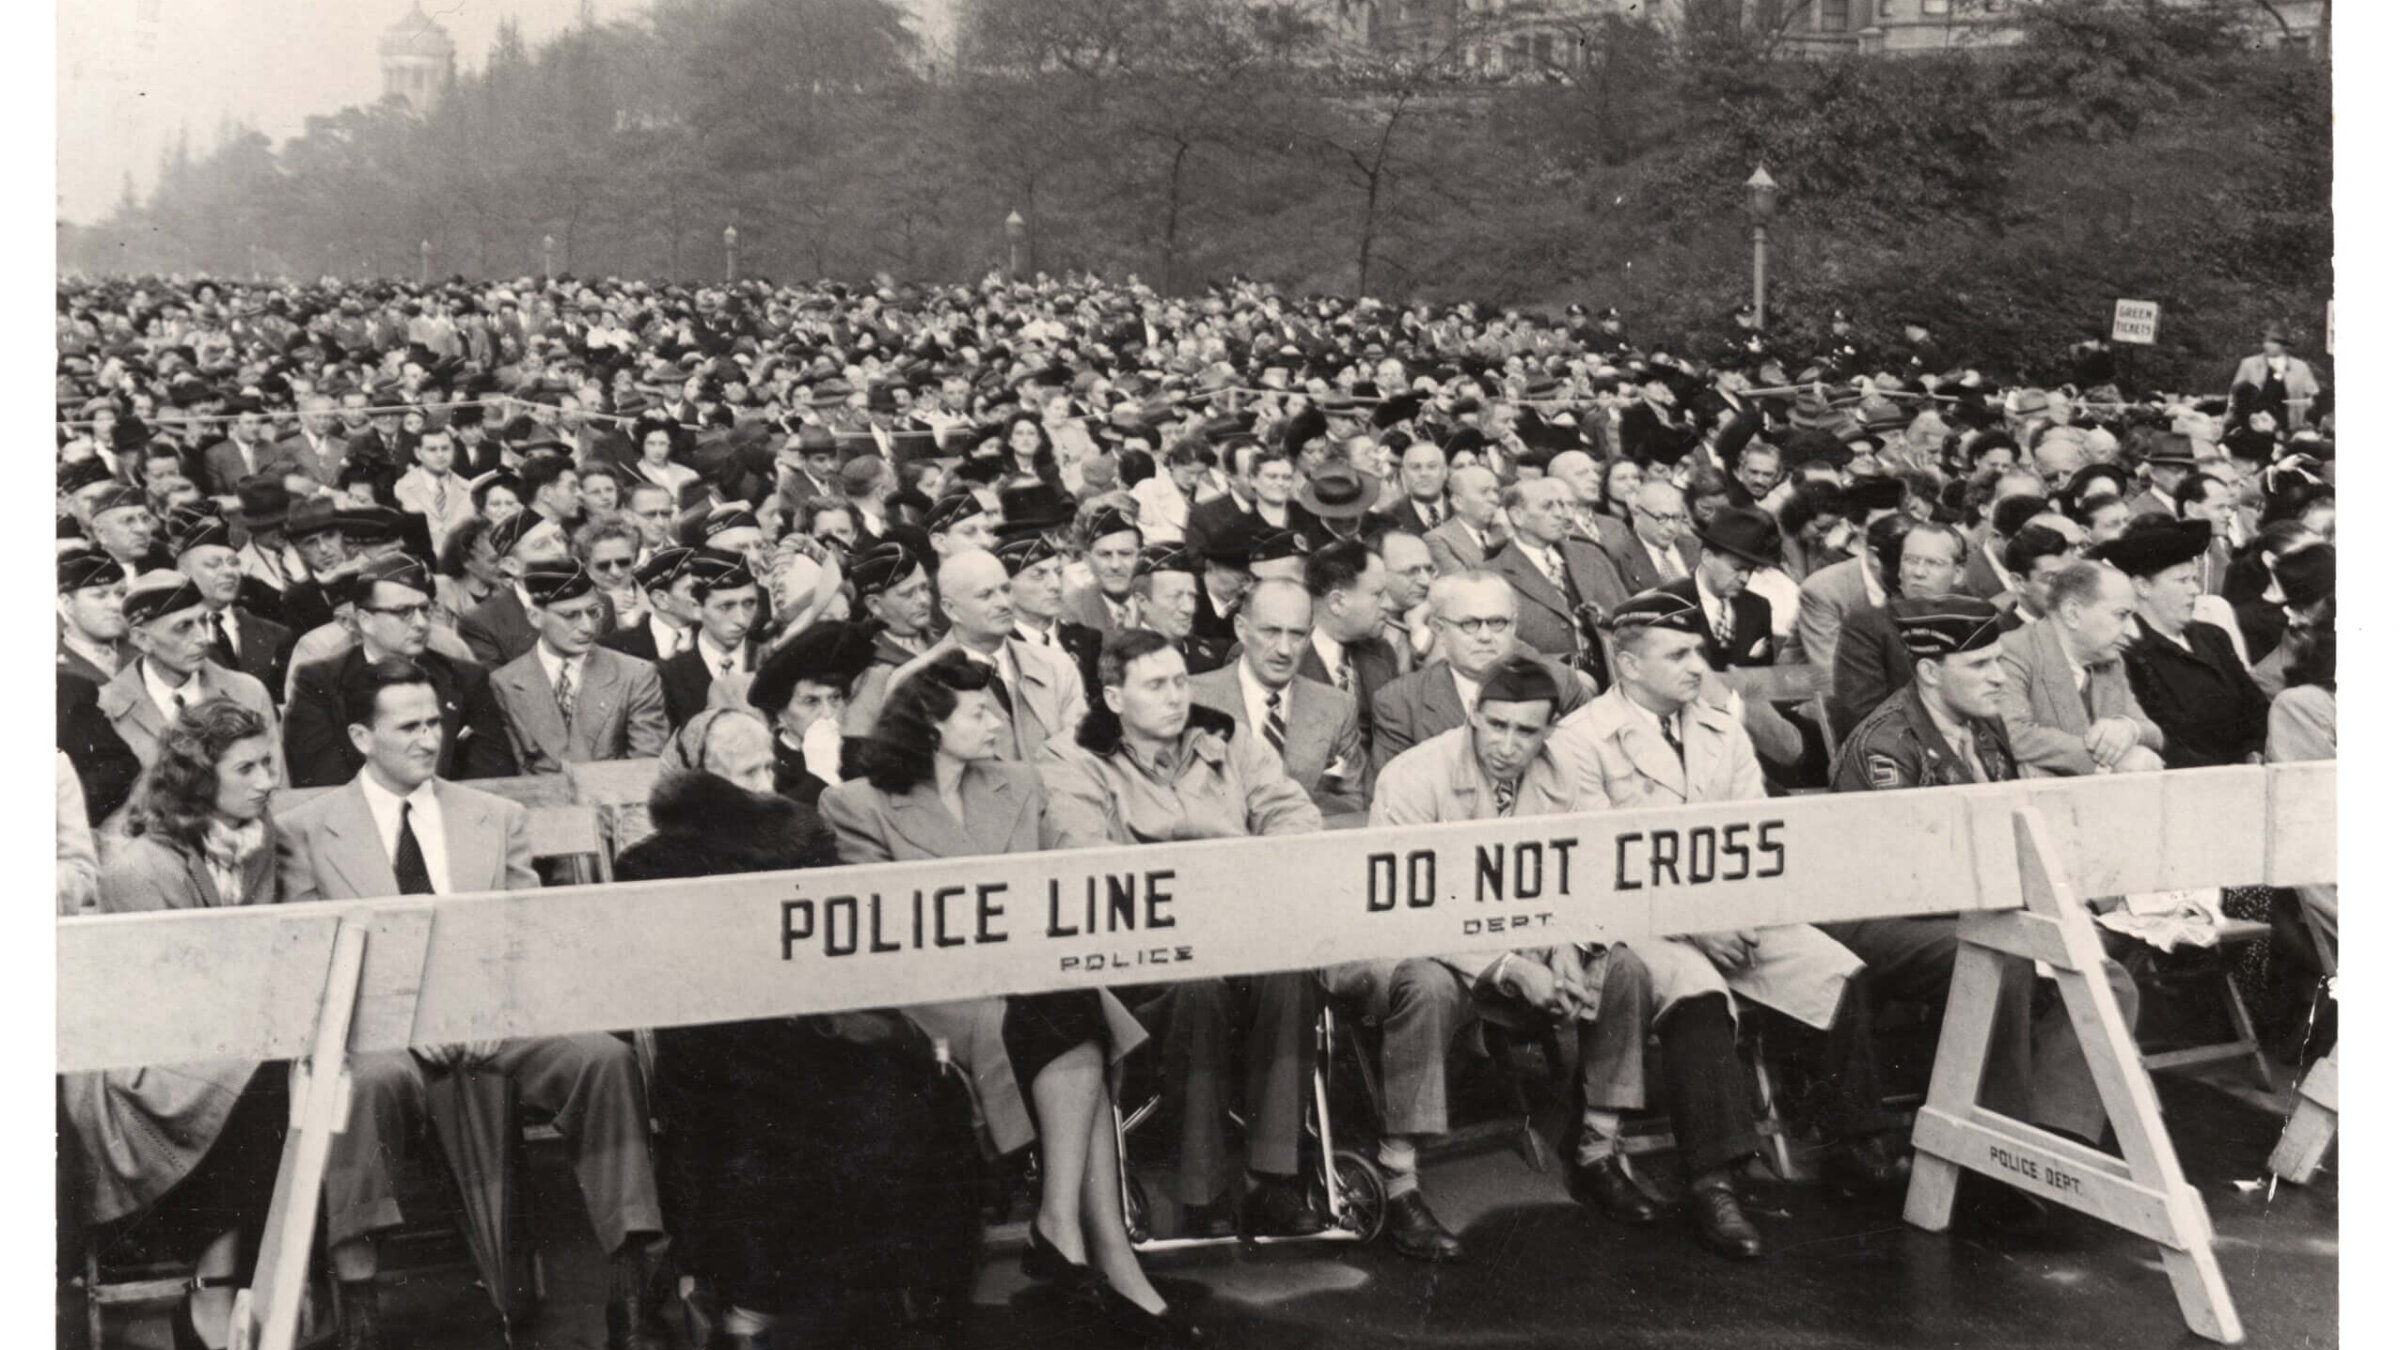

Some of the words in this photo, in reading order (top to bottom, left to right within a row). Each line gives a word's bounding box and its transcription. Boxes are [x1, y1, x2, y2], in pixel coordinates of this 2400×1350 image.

[2118, 305, 2152, 320] GREEN
[2116, 320, 2151, 336] TICKETS
[1367, 849, 1436, 912] DO
[1475, 837, 1579, 902] NOT
[1614, 820, 1785, 891] CROSS
[781, 883, 1009, 960] POLICE
[1046, 870, 1176, 938] LINE
[1060, 945, 1194, 972] POLICE
[1990, 1146, 2037, 1179] POLICE
